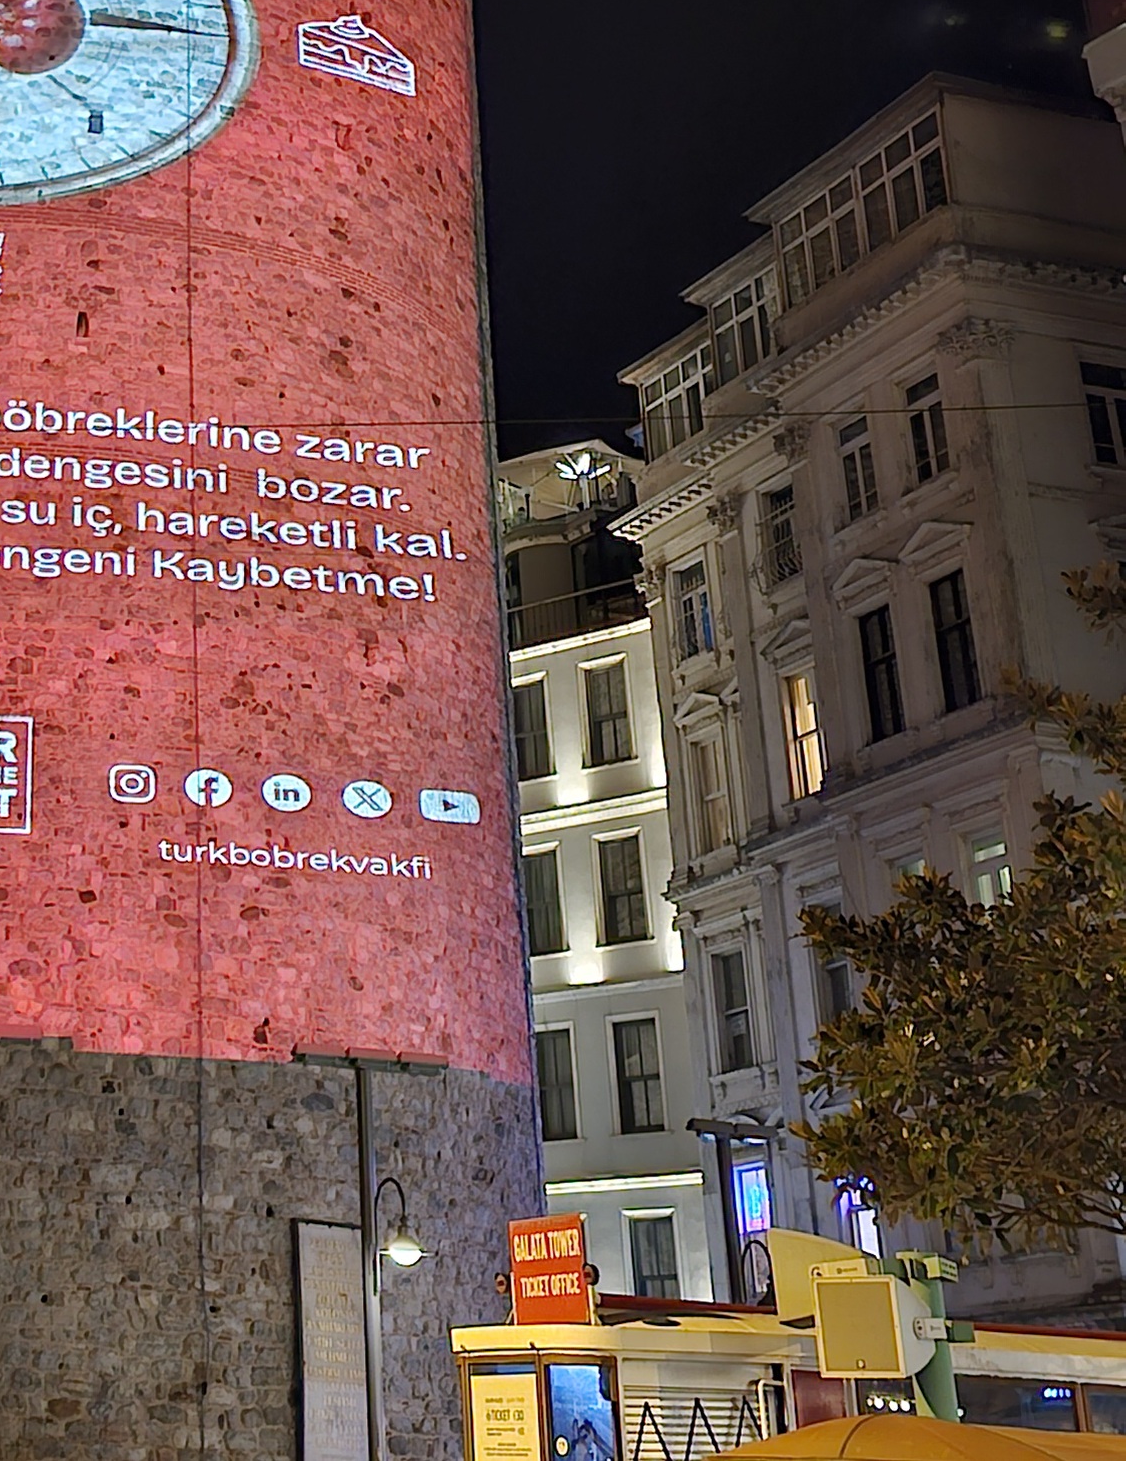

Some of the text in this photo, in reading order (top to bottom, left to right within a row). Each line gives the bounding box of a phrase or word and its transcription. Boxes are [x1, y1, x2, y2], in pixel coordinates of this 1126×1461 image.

[295, 433, 431, 470] zarar
[256, 469, 412, 513] bozar.
[0, 499, 57, 527] su
[72, 496, 123, 539] iç,
[136, 501, 357, 552] hareketli
[375, 524, 468, 562] kal.
[153, 549, 437, 603] Kaybetme!
[159, 840, 432, 880] turkbobrekvakfi
[514, 1228, 581, 1262] GALATA TOWER
[520, 1272, 581, 1298] TICKET OFFICE
